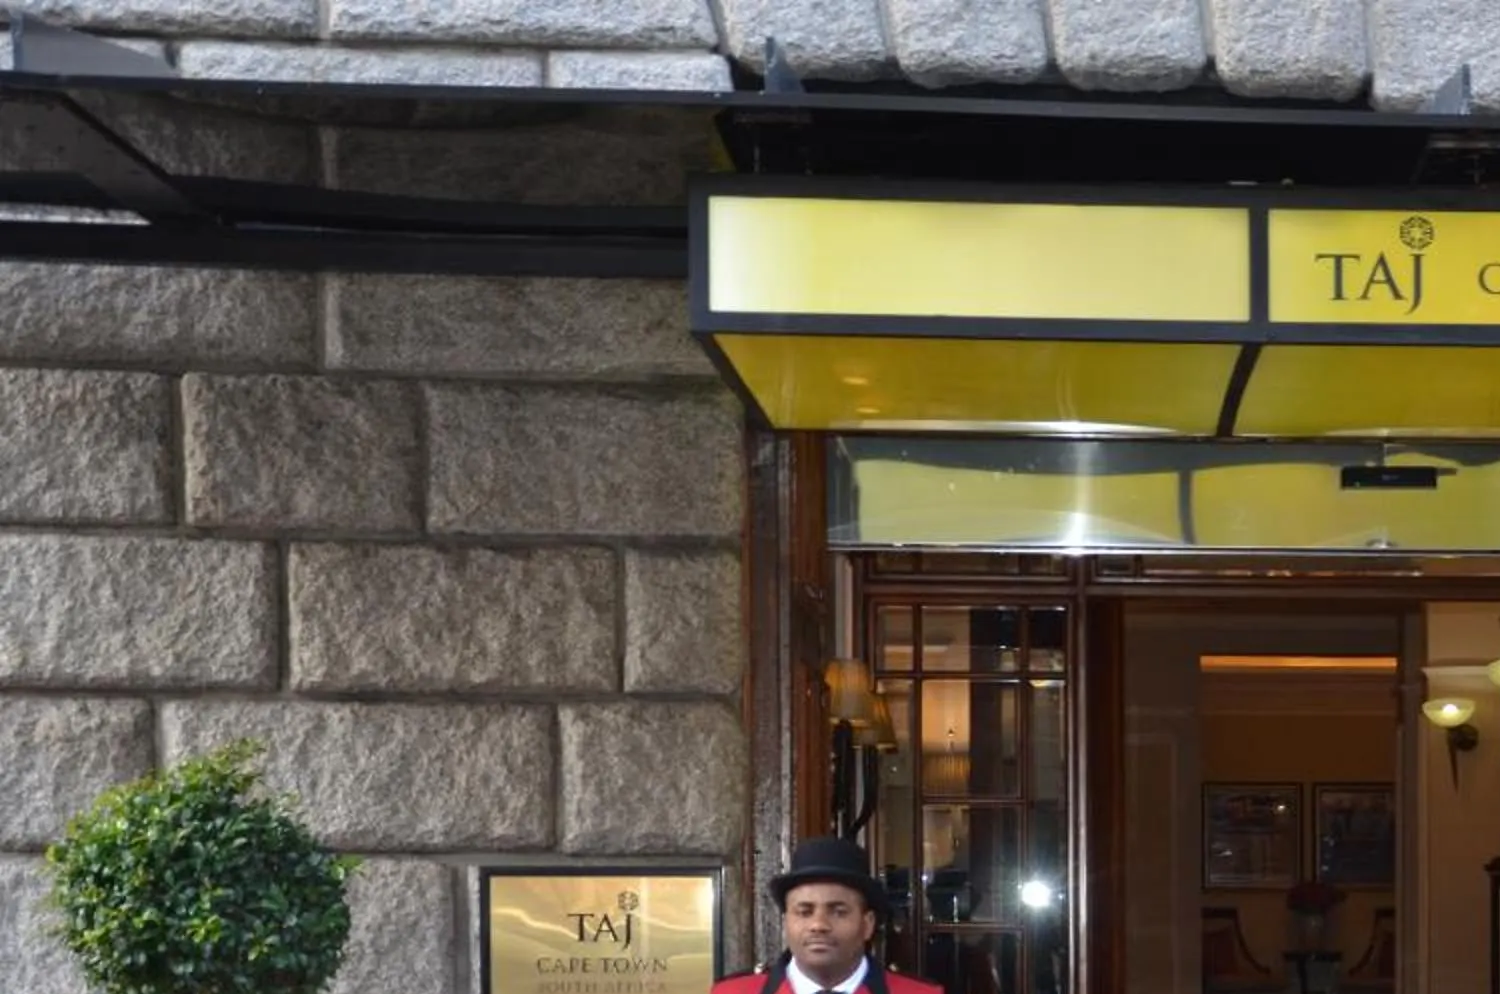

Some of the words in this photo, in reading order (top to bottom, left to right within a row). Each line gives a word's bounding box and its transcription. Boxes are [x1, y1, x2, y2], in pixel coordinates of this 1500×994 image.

[1315, 252, 1427, 315] TAJ
[567, 913, 633, 949] TAJ
[536, 957, 594, 974] CAPE
[599, 957, 668, 974] TOWN
